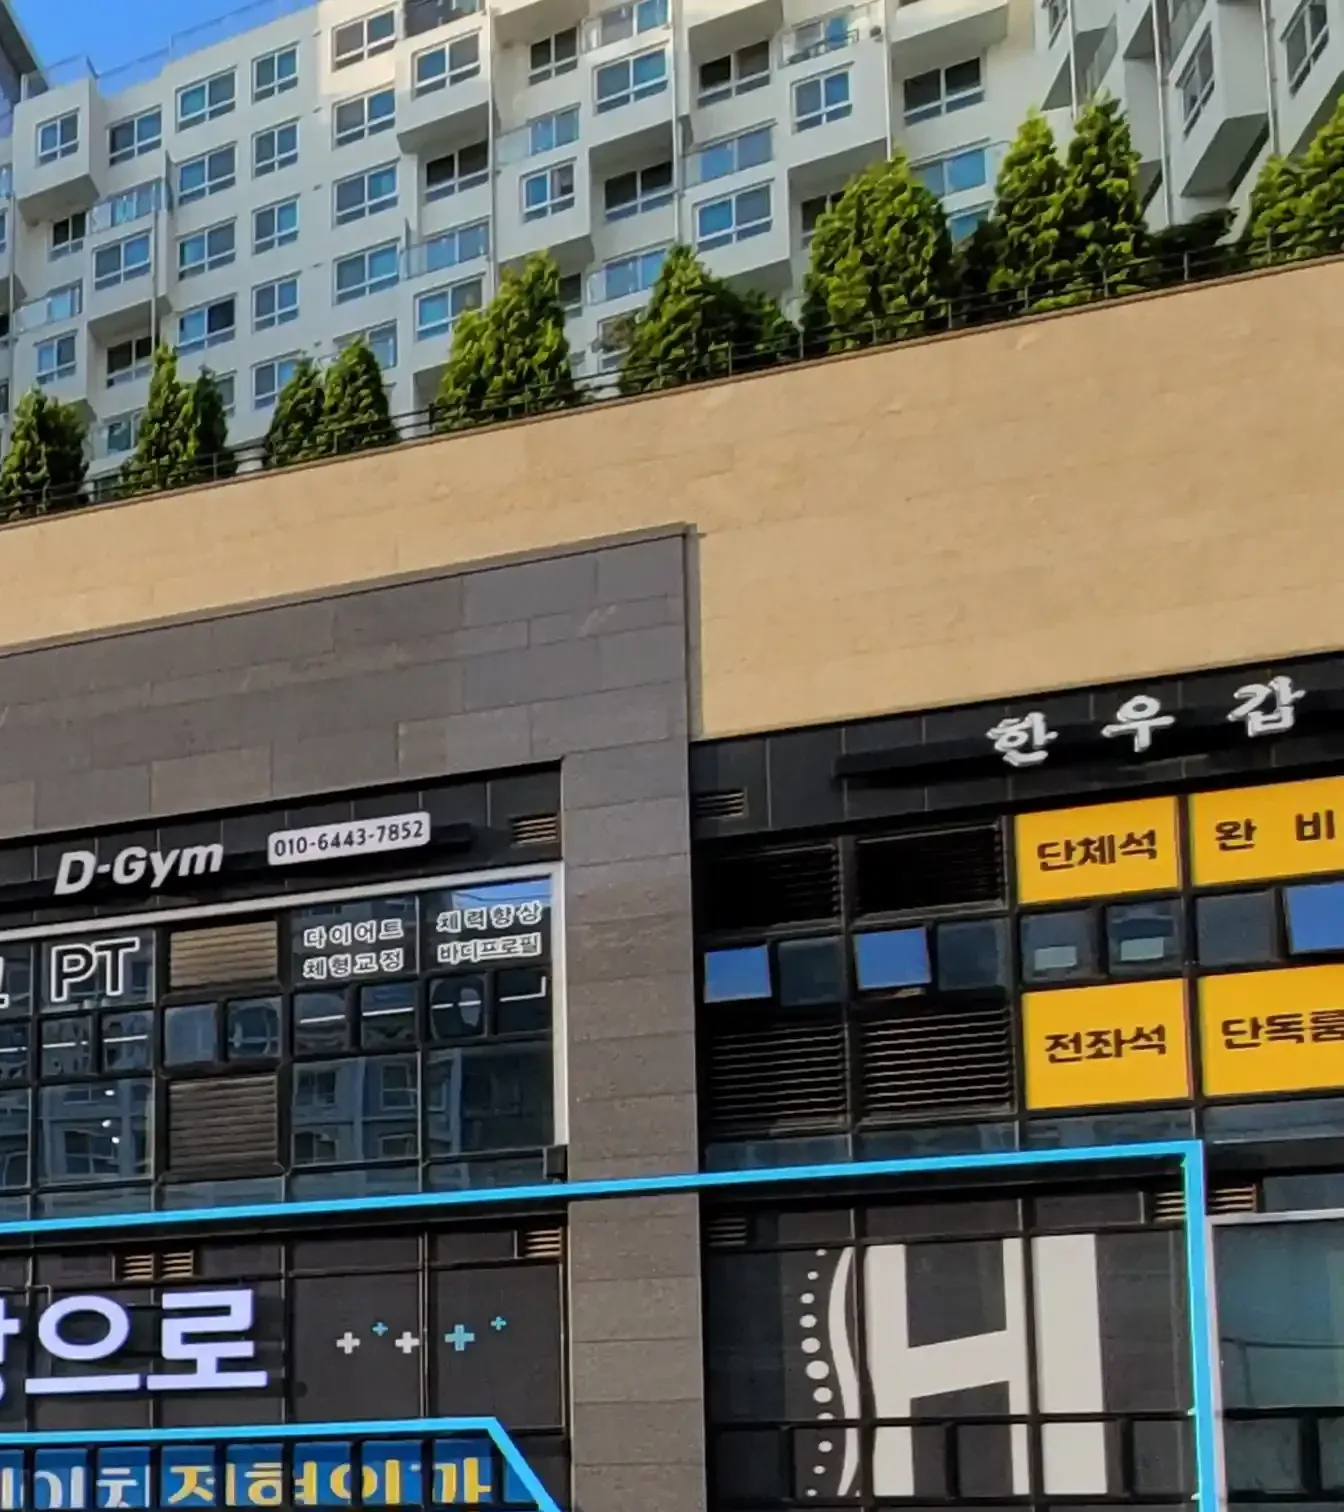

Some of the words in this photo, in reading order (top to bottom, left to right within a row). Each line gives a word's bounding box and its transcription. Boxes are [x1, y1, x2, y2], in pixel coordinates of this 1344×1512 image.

[273, 819, 425, 859] 010-6443-7852
[1037, 829, 1157, 872] 단체석
[53, 842, 224, 895] D-Gym
[303, 918, 404, 948] 다이어트
[435, 900, 542, 933] 체력향상
[50, 936, 141, 1001] PT
[302, 947, 404, 979] 체형교정
[437, 932, 542, 965] 바디프로필
[1044, 1024, 1167, 1064] 전좌석
